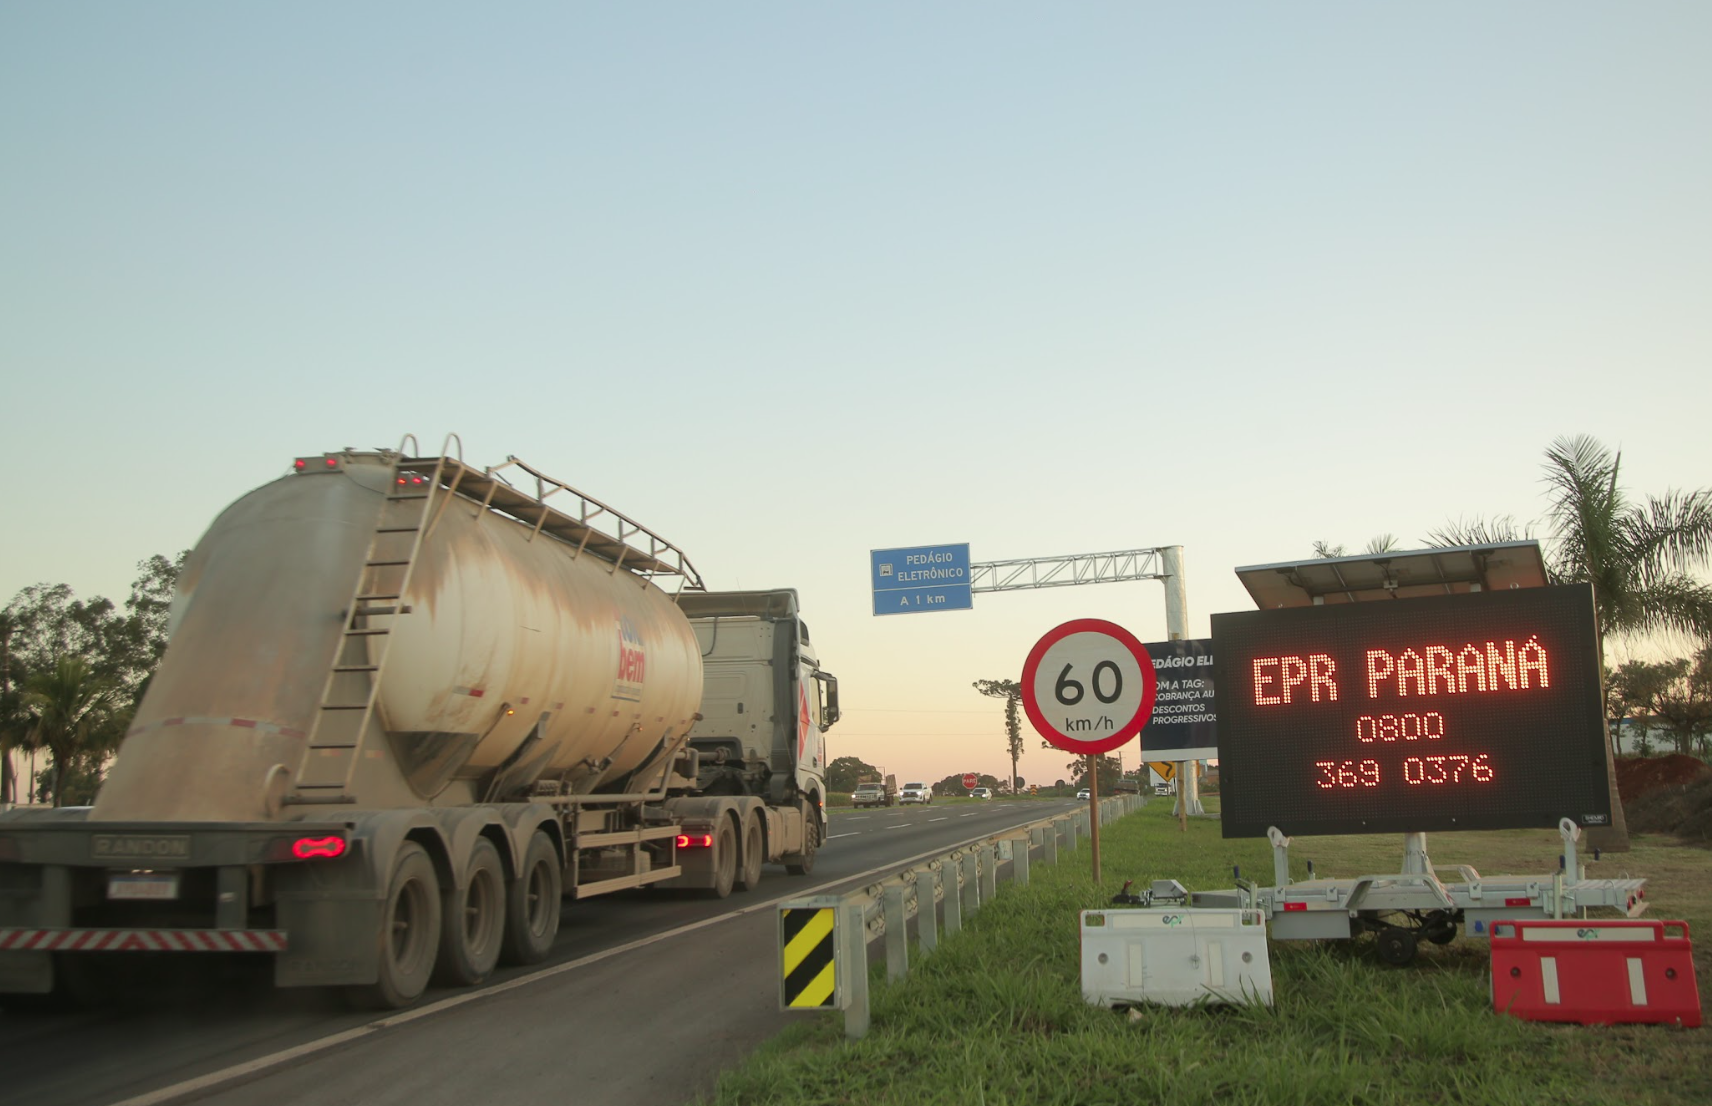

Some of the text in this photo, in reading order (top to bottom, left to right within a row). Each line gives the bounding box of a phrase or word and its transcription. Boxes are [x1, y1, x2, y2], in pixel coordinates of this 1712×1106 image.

[906, 551, 953, 565] PEDÁGIO
[898, 566, 963, 581] ELETRÔNICO
[900, 594, 945, 606] A 1 km
[1253, 635, 1549, 706] EPR PARANÁ
[1055, 660, 1123, 706] 60
[1171, 680, 1179, 690] A
[1181, 678, 1205, 689] TAG:
[1155, 690, 1201, 701] OBRANÇA
[1152, 703, 1206, 714] DESCONTOS
[1065, 715, 1114, 731] km/h
[1356, 711, 1444, 743] 0800
[1316, 753, 1493, 788] 369 0376
[96, 839, 187, 855] RANDON
